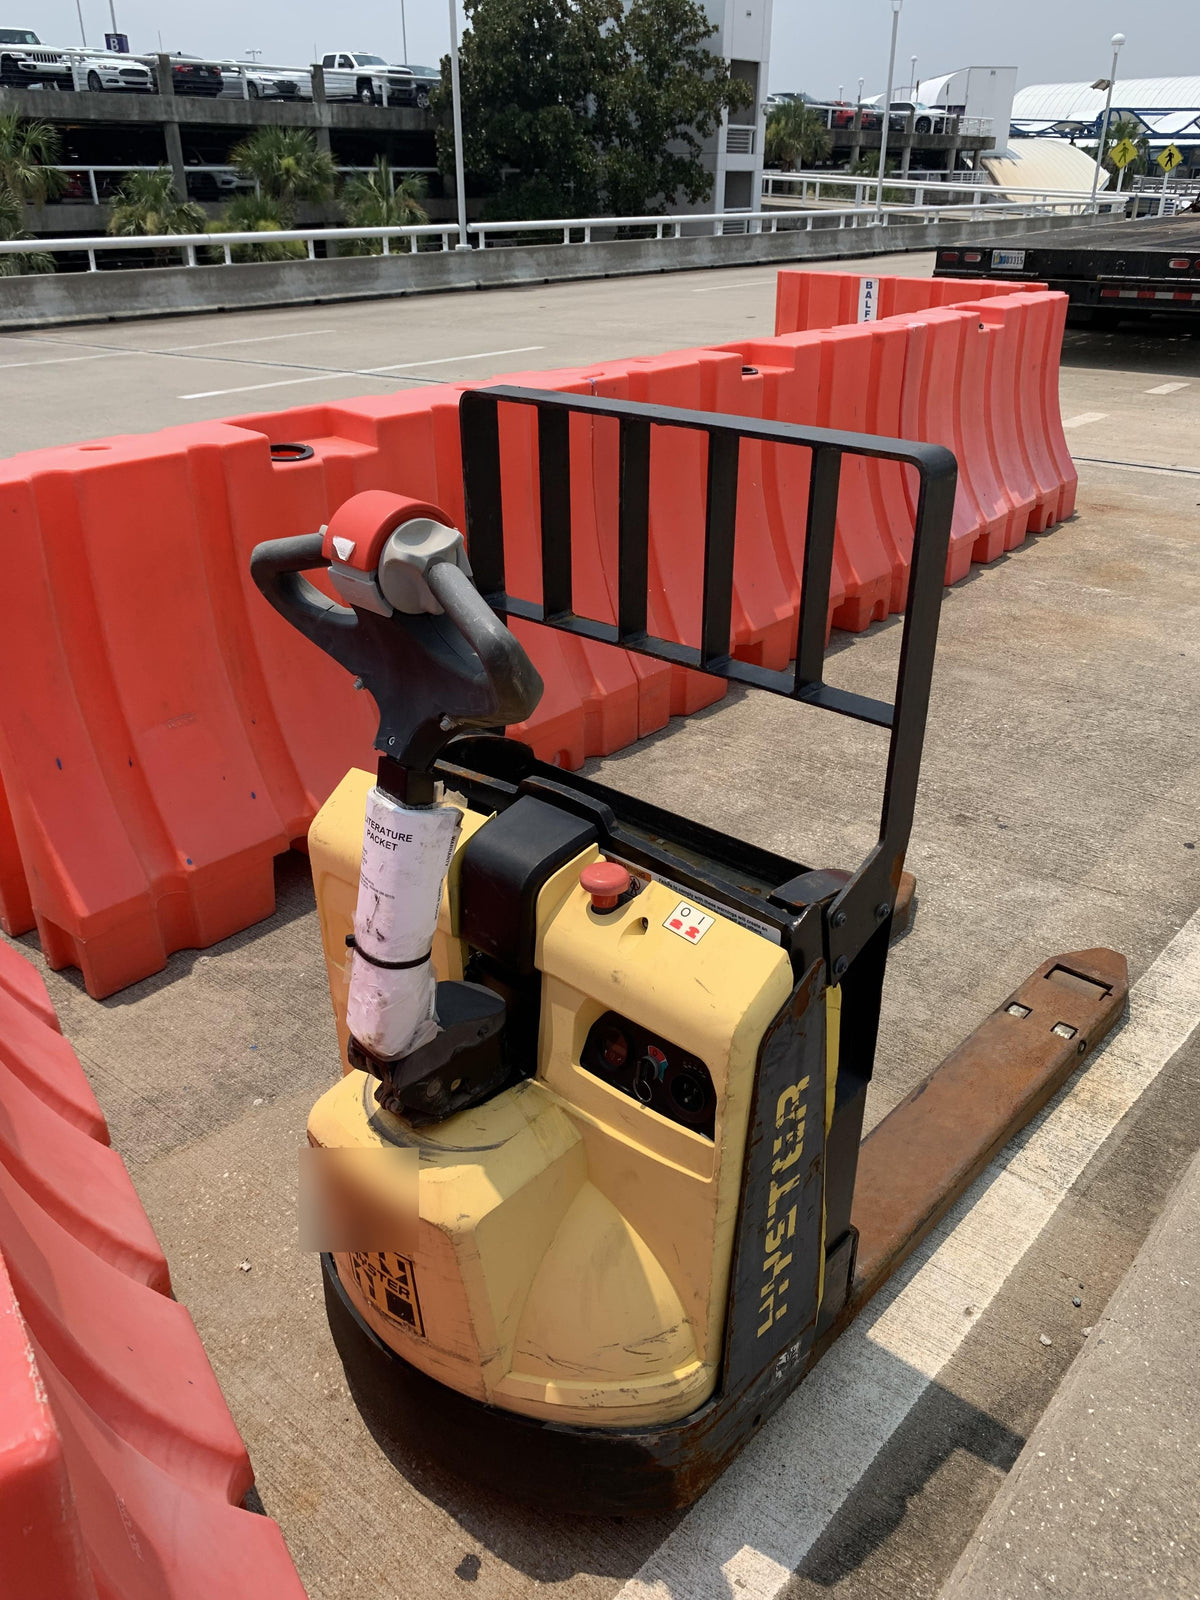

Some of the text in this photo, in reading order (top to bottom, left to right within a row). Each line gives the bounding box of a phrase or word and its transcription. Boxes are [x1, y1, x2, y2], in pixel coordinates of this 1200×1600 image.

[110, 38, 119, 51] B
[864, 281, 873, 322] BALF
[367, 829, 398, 851] PACKET
[445, 835, 457, 867] WARRANTY
